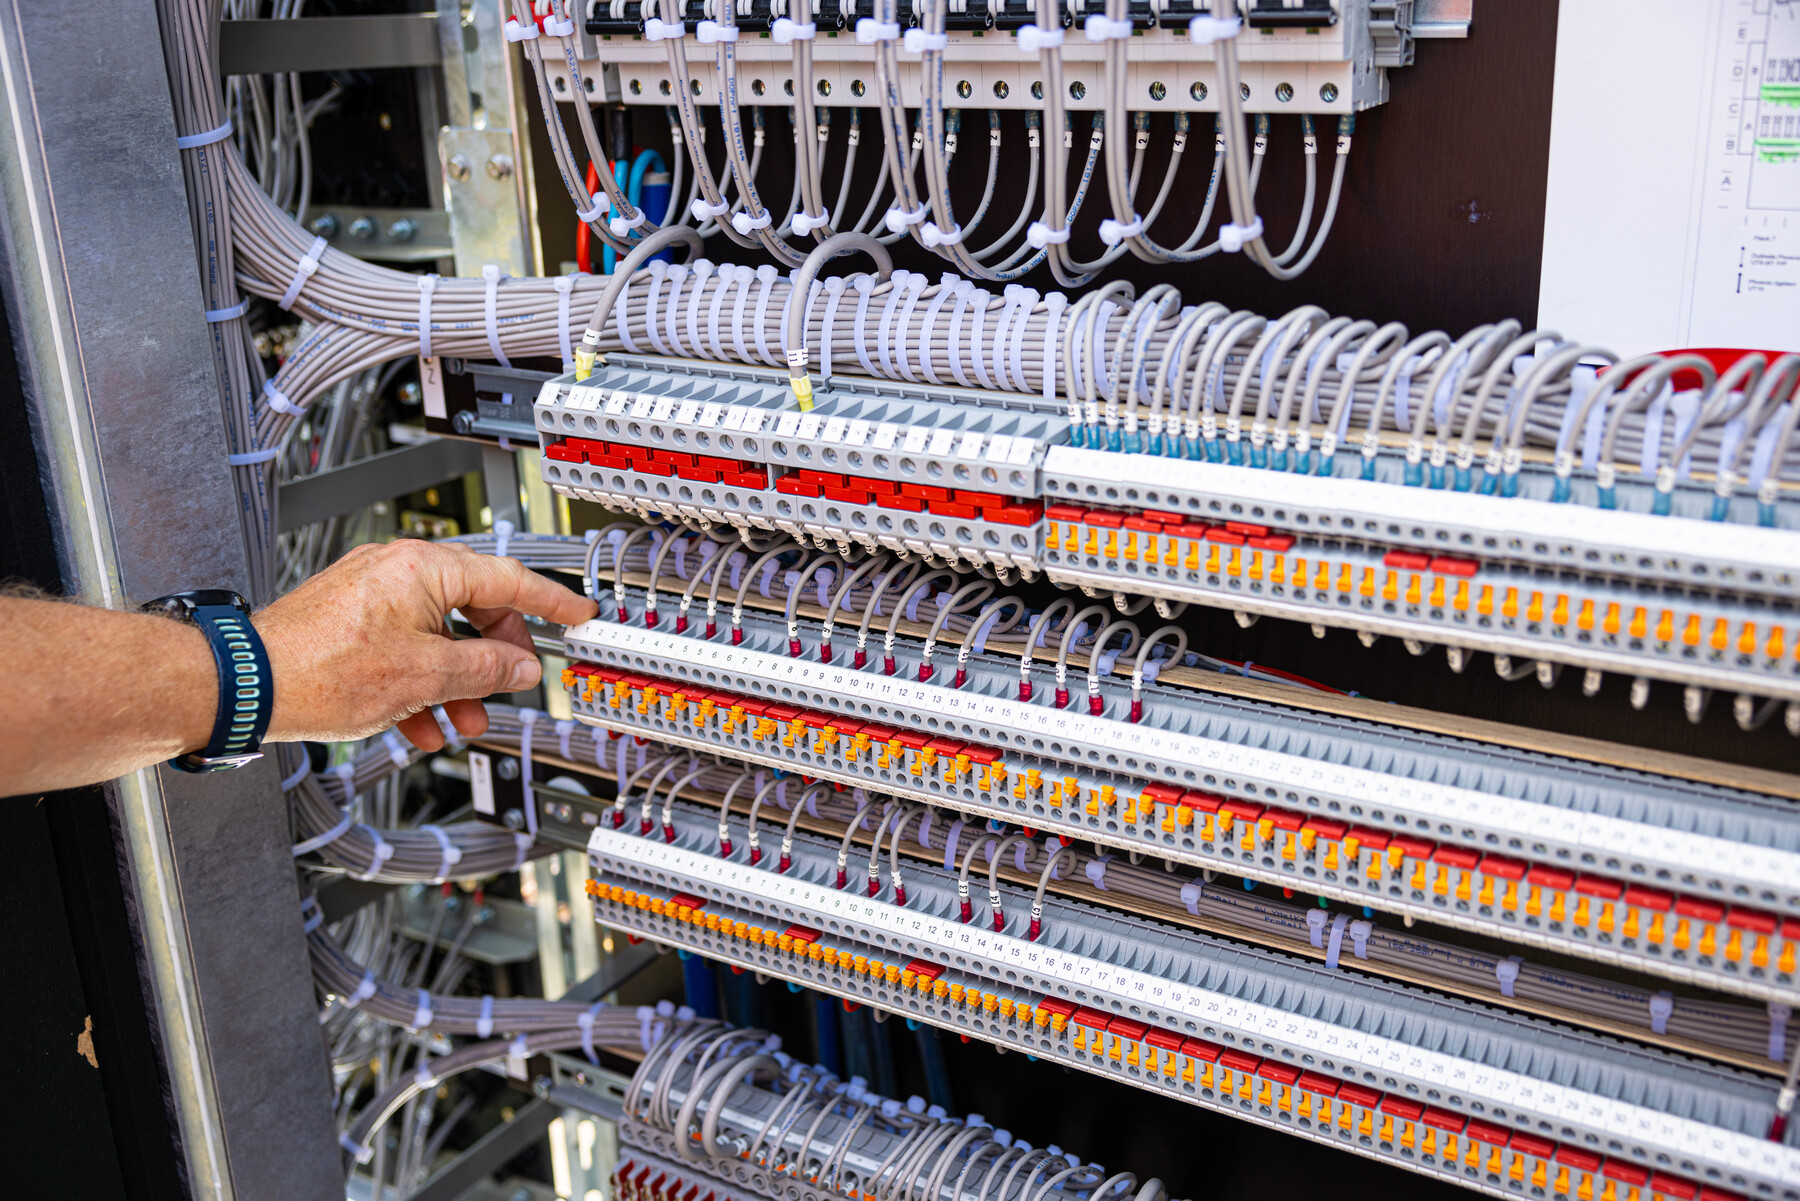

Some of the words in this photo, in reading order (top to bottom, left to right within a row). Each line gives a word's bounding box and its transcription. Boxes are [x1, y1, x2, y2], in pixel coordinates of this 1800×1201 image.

[997, 568, 1006, 577] 18
[1023, 660, 1032, 670] 15
[1090, 680, 1099, 691] 17
[833, 675, 843, 683] 10
[849, 678, 859, 686] 10
[865, 682, 875, 690] 11
[881, 685, 892, 693] 11
[898, 688, 909, 696] 12
[915, 691, 925, 700] 12
[932, 695, 942, 703] 13
[949, 698, 959, 706] 13
[967, 702, 977, 710] 14
[984, 705, 994, 713] 14
[1001, 708, 1011, 717] 15
[1019, 712, 1030, 720] 15
[960, 885, 968, 894] 13
[991, 896, 999, 904] 14
[1264, 916, 1302, 928] ProRail
[864, 908, 874, 916] 10
[880, 912, 890, 920] 11
[896, 917, 906, 925] 11
[911, 921, 921, 929] 12
[928, 926, 938, 934] 12
[944, 930, 954, 938] 13
[960, 934, 970, 942] 13
[977, 939, 987, 947] 14
[994, 944, 1004, 952] 14
[1011, 948, 1021, 956] 15
[1028, 953, 1038, 961] 15
[1045, 958, 1056, 966] 16
[1062, 962, 1073, 971] 16
[1080, 967, 1091, 976] 17
[1098, 972, 1109, 981] 17
[1116, 977, 1126, 986] 18
[1134, 982, 1145, 991] 18
[1152, 987, 1163, 996] 19
[1171, 992, 1182, 1001] 19
